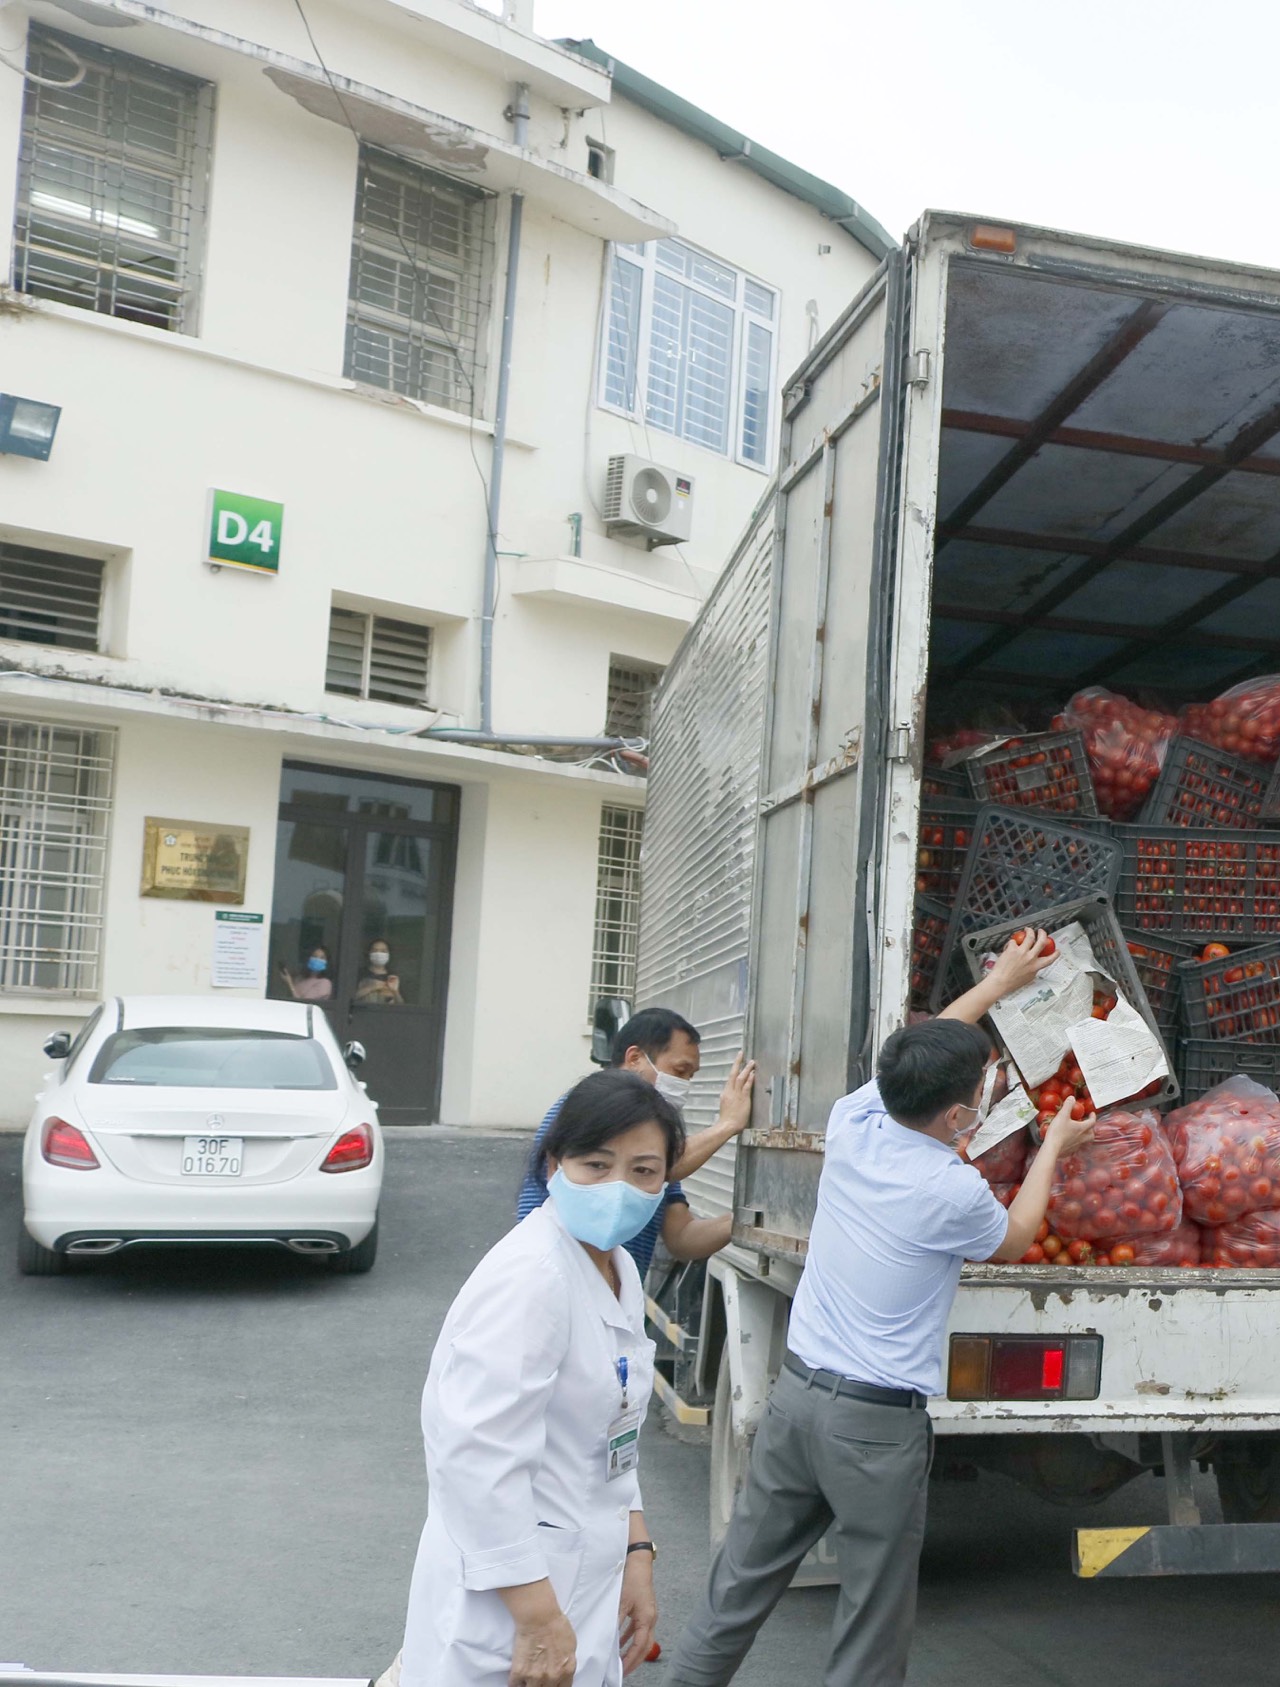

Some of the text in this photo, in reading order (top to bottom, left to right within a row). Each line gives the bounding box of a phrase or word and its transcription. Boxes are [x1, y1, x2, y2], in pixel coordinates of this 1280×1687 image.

[216, 509, 275, 553] D4
[197, 1138, 229, 1155] 30F
[183, 1157, 240, 1174] 016.70
